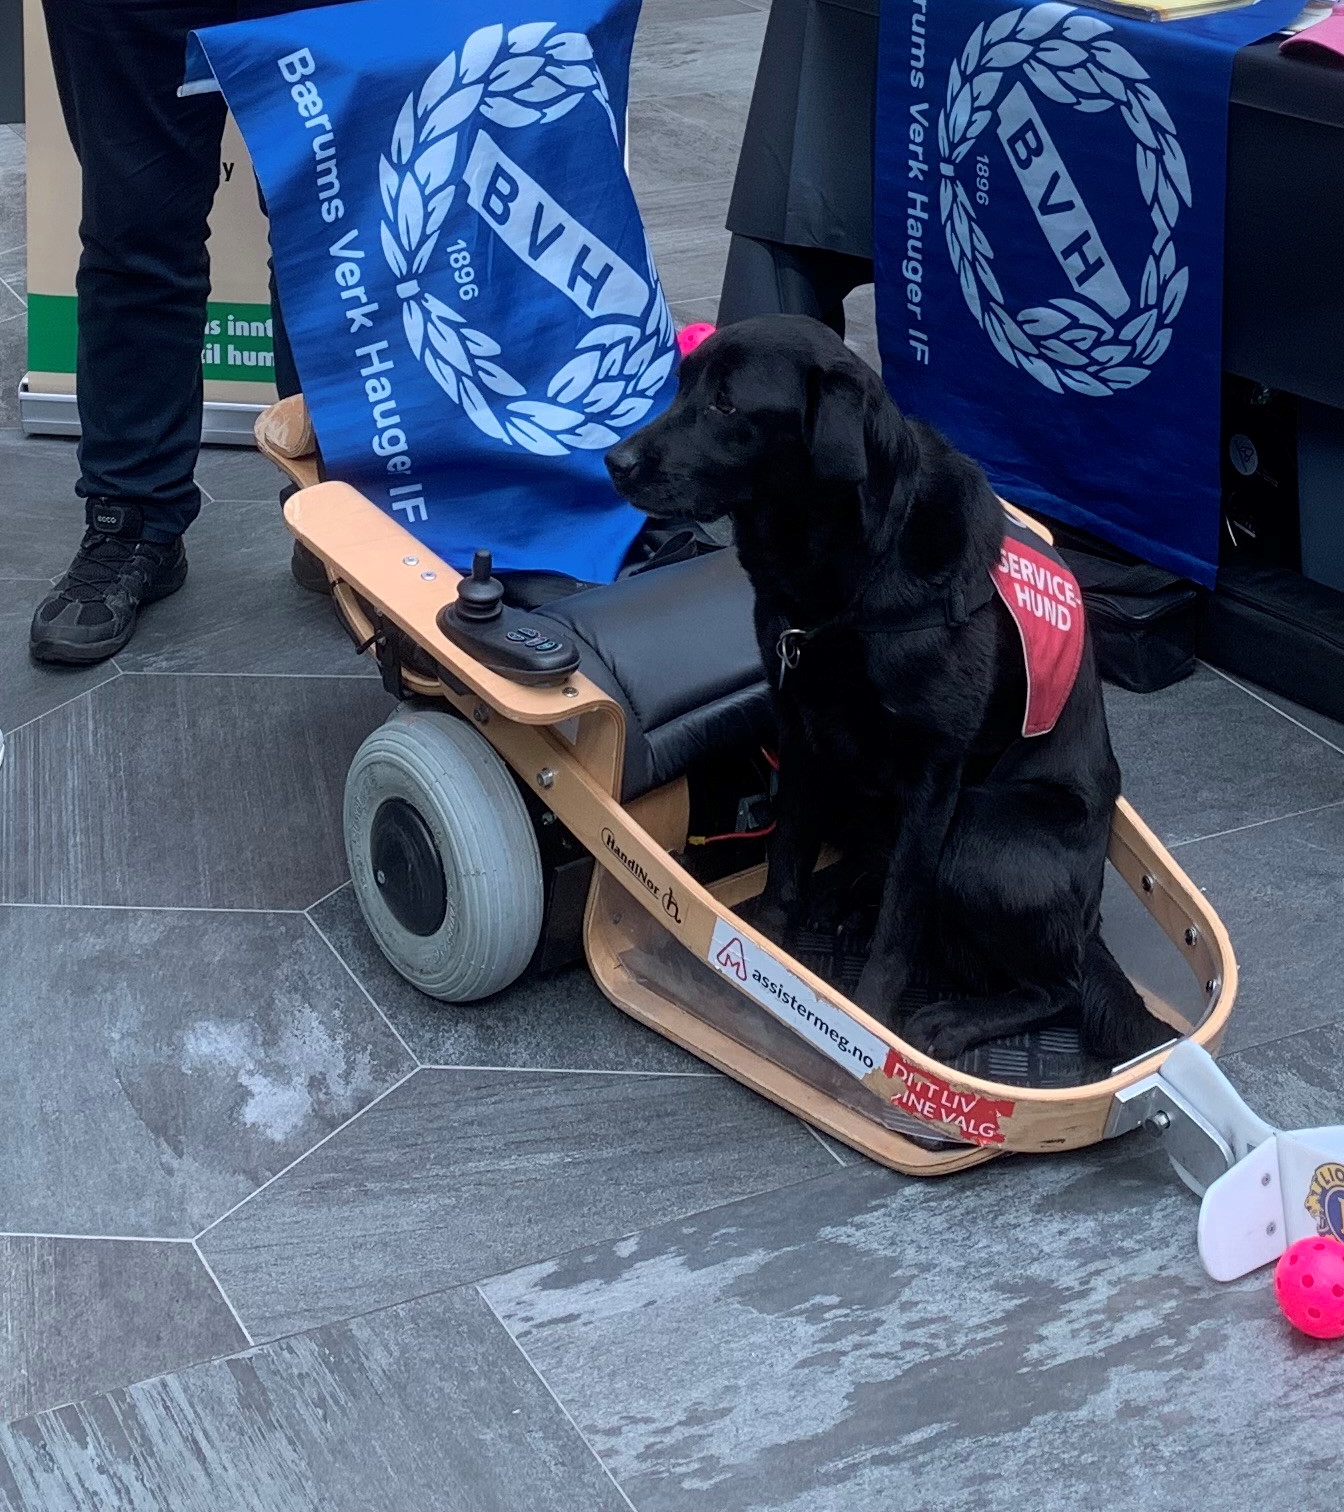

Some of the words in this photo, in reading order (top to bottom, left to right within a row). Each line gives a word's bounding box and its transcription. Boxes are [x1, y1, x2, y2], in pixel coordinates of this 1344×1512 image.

[908, 101, 932, 180] Verk
[973, 154, 991, 206] 1896
[1005, 122, 1106, 289] BVH
[480, 164, 615, 312] BVH
[905, 195, 932, 323] Hauger
[277, 47, 345, 223] Bærums
[329, 229, 376, 333] Verk
[391, 481, 429, 525] IF
[446, 239, 479, 302] 1896
[909, 331, 930, 365] IF
[998, 549, 1082, 608] SERVICE-
[1013, 582, 1072, 632] HUND
[751, 967, 874, 1070] assistermeg.no
[894, 1090, 937, 1119] INE
[940, 1107, 996, 1138] VALG
[941, 1090, 981, 1114] LIV
